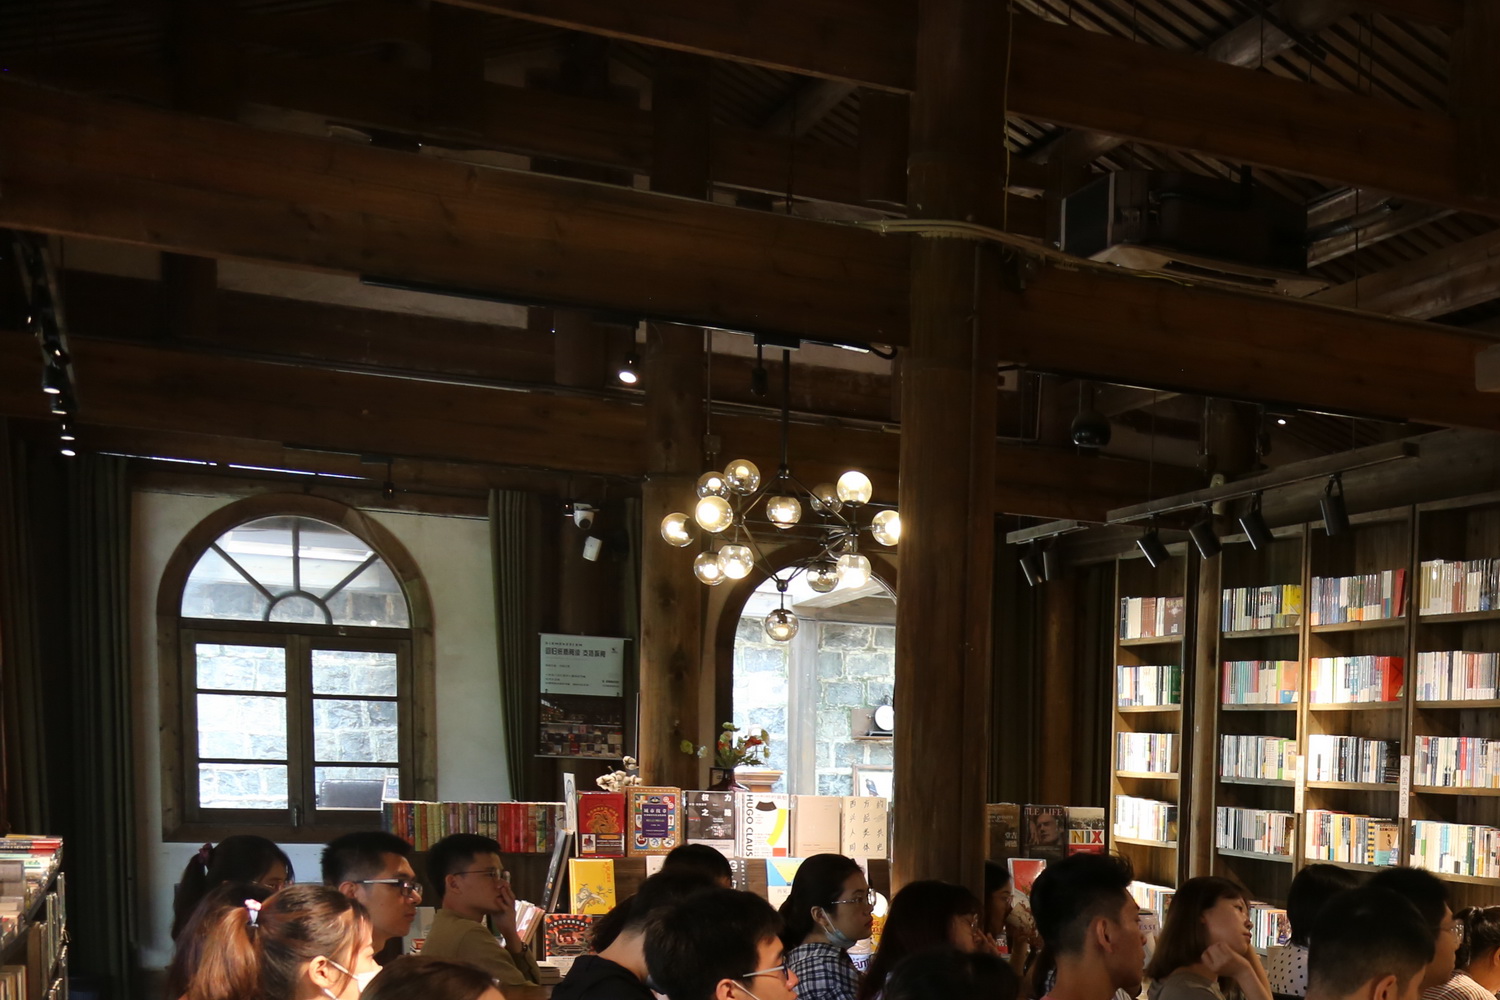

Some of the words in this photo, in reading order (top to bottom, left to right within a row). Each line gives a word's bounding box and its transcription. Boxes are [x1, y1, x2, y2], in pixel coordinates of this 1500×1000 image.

[746, 794, 754, 825] HUGO
[1043, 807, 1063, 816] LIFE
[746, 827, 754, 857] CLAUS
[1071, 831, 1103, 845] NIX
